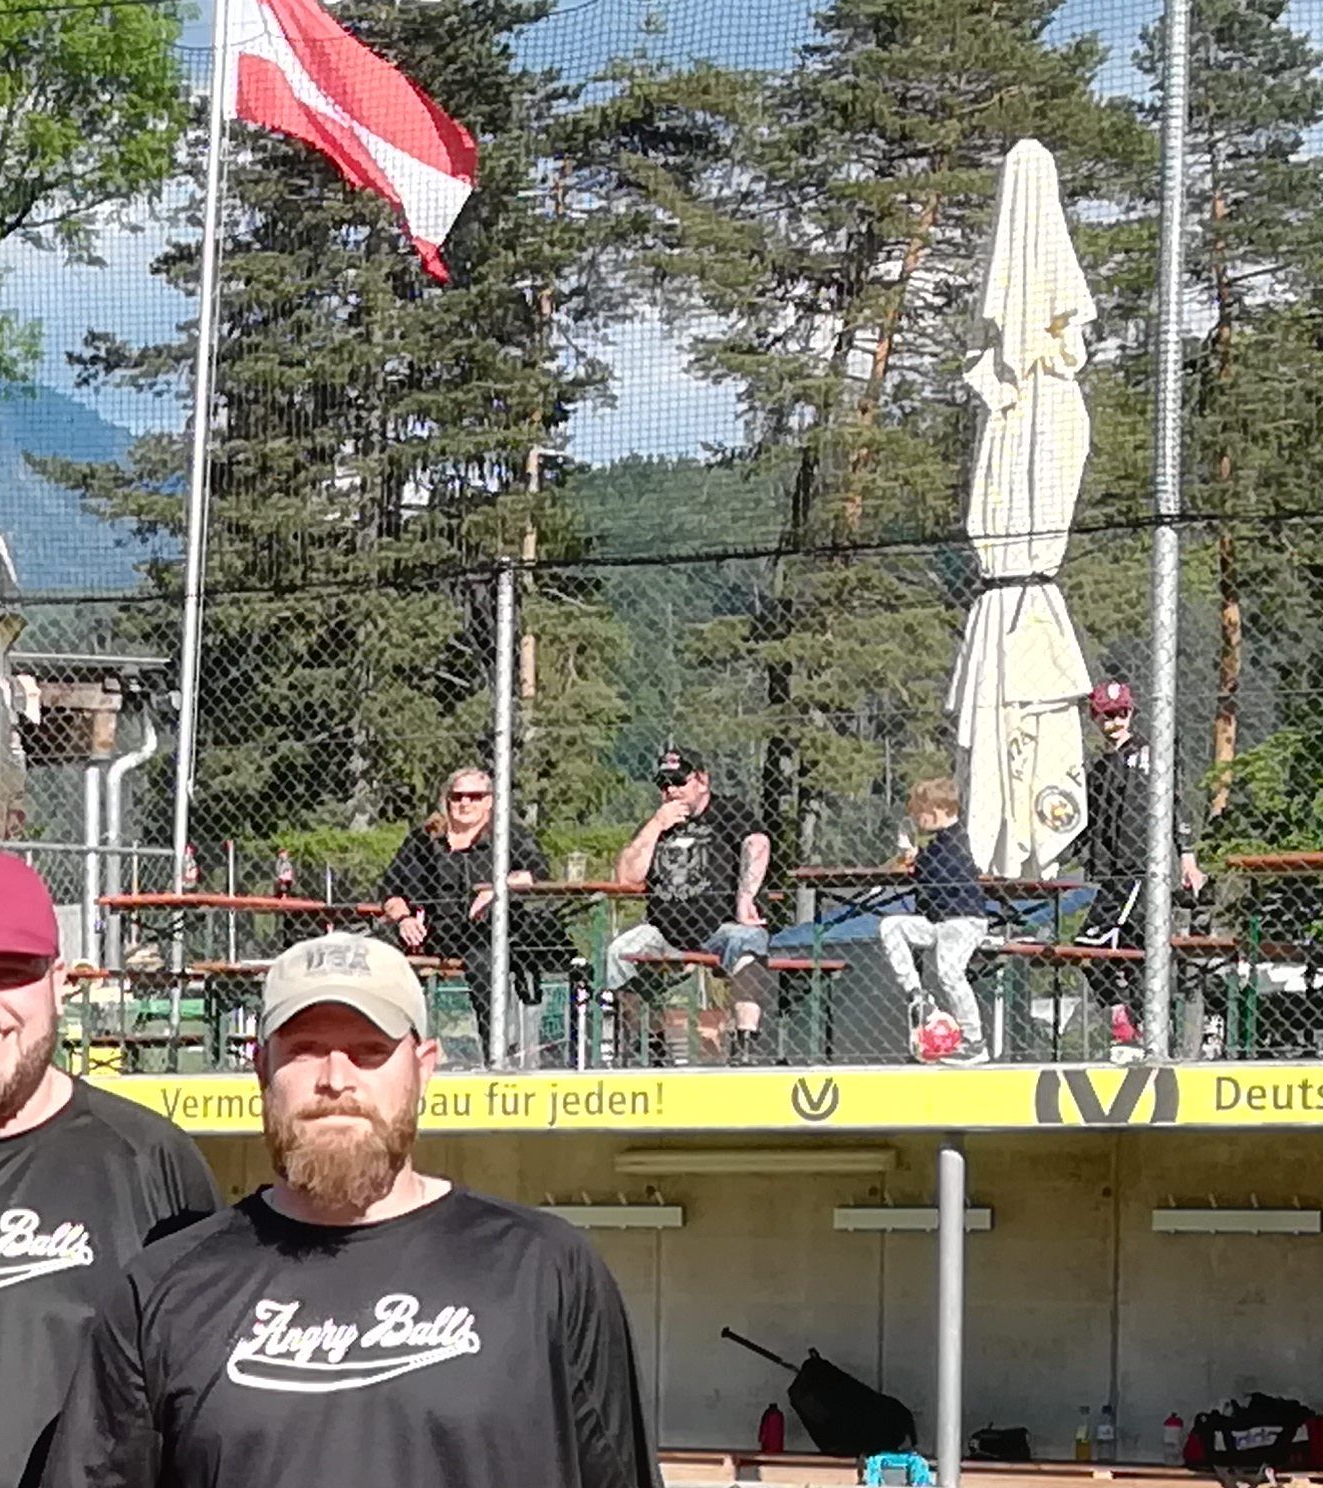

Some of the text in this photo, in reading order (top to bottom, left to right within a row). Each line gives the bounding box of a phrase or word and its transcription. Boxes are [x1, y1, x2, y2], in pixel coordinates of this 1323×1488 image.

[485, 1082, 536, 1117] für
[548, 1080, 663, 1127] jeden!
[242, 1293, 480, 1363] Angry Balls
